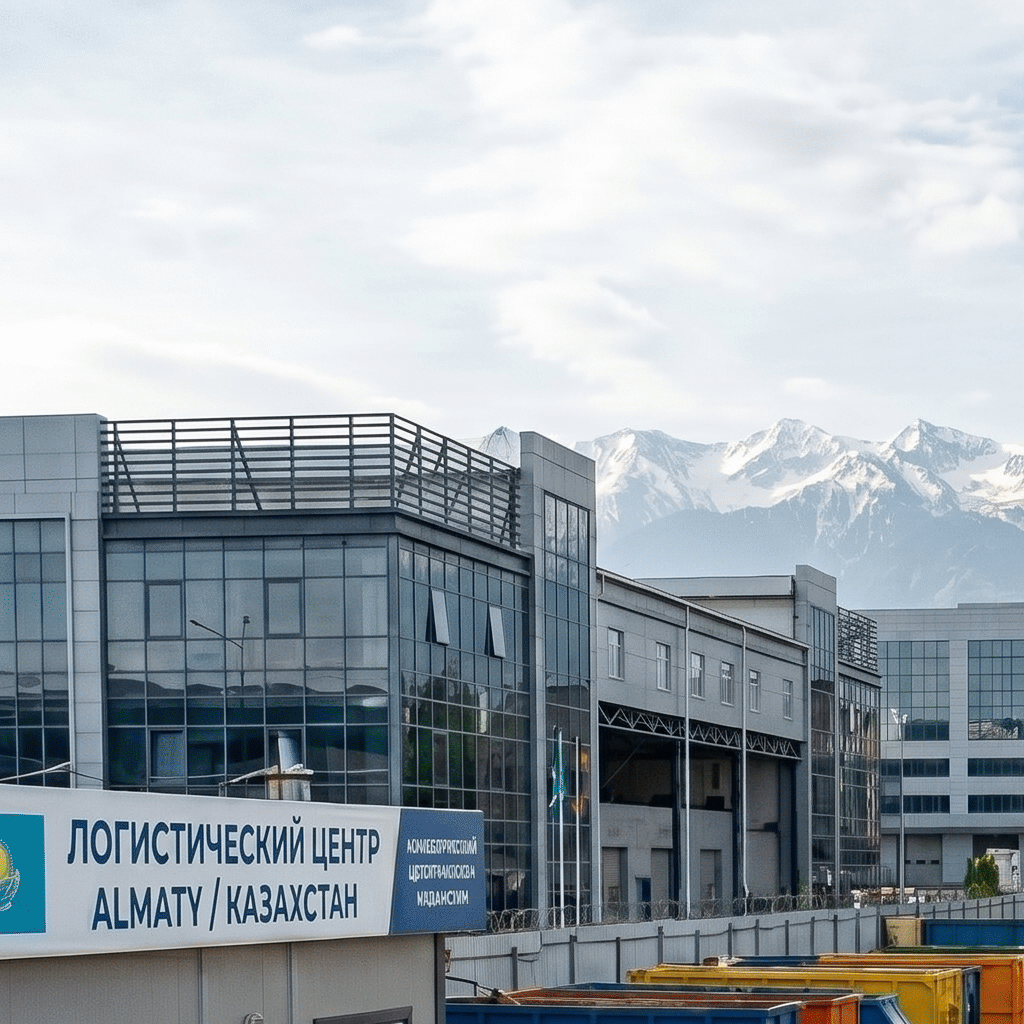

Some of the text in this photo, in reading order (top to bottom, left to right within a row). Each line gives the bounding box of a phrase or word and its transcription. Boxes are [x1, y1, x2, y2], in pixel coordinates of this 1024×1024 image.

[67, 815, 305, 865] ЛОГИСТИЧЕСКИЙ
[312, 826, 380, 871] ЦЕНТР
[91, 886, 203, 930] ALMATY
[227, 883, 358, 925] КАЗАХСТАН
